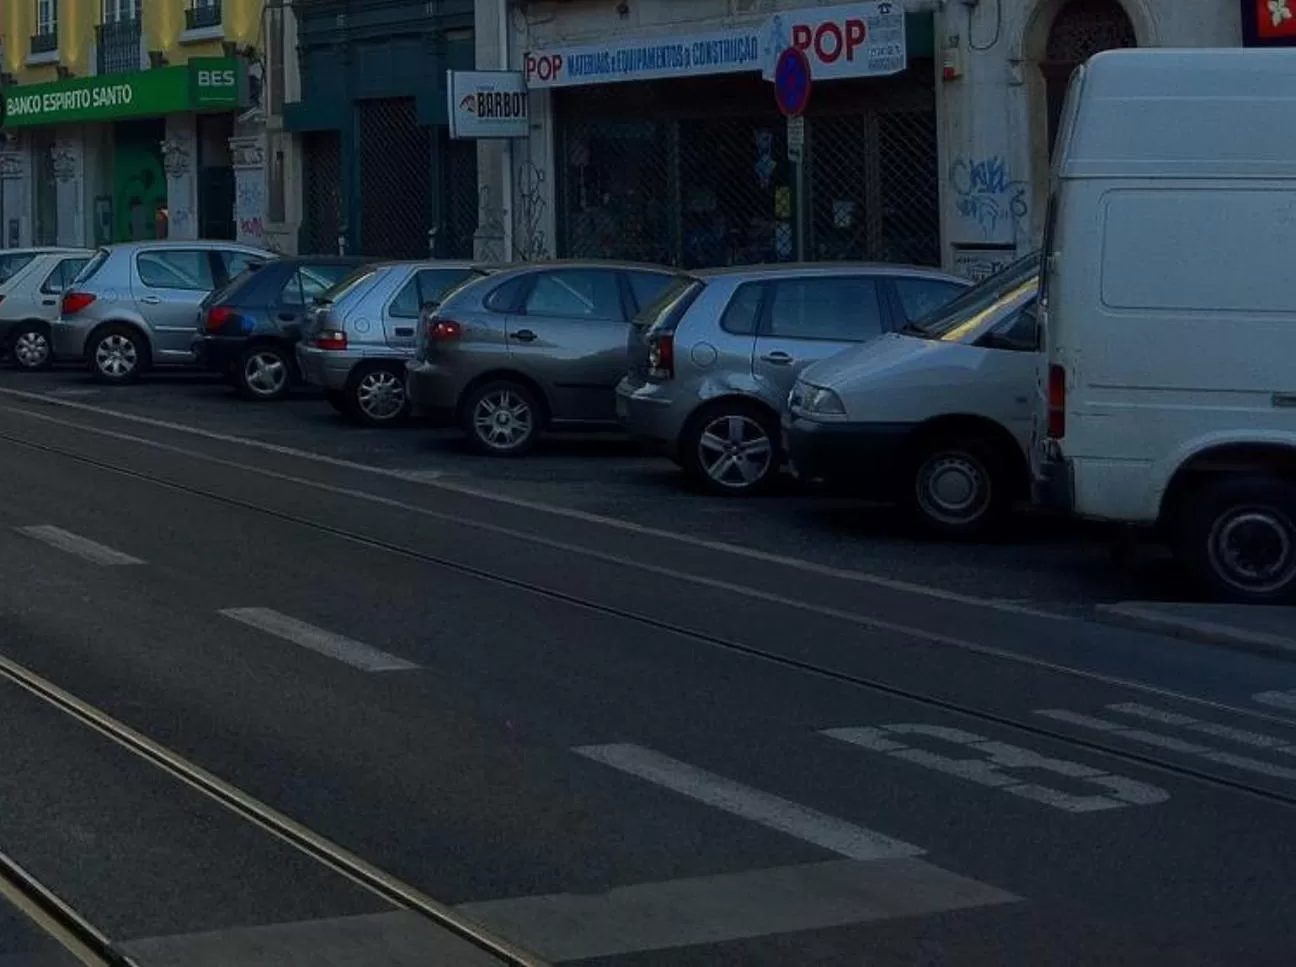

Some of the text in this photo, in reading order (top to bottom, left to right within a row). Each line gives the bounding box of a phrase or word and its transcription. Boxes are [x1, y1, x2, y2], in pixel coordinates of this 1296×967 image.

[792, 19, 866, 64] POP
[524, 52, 563, 82] POP
[616, 43, 683, 75] EQUIPAMENTOS
[692, 35, 758, 66] CONSTRUÇÃO
[198, 70, 235, 87] BES
[6, 84, 133, 116] BANCO ESPIRITO SANTO
[477, 92, 528, 117] BARBOT
